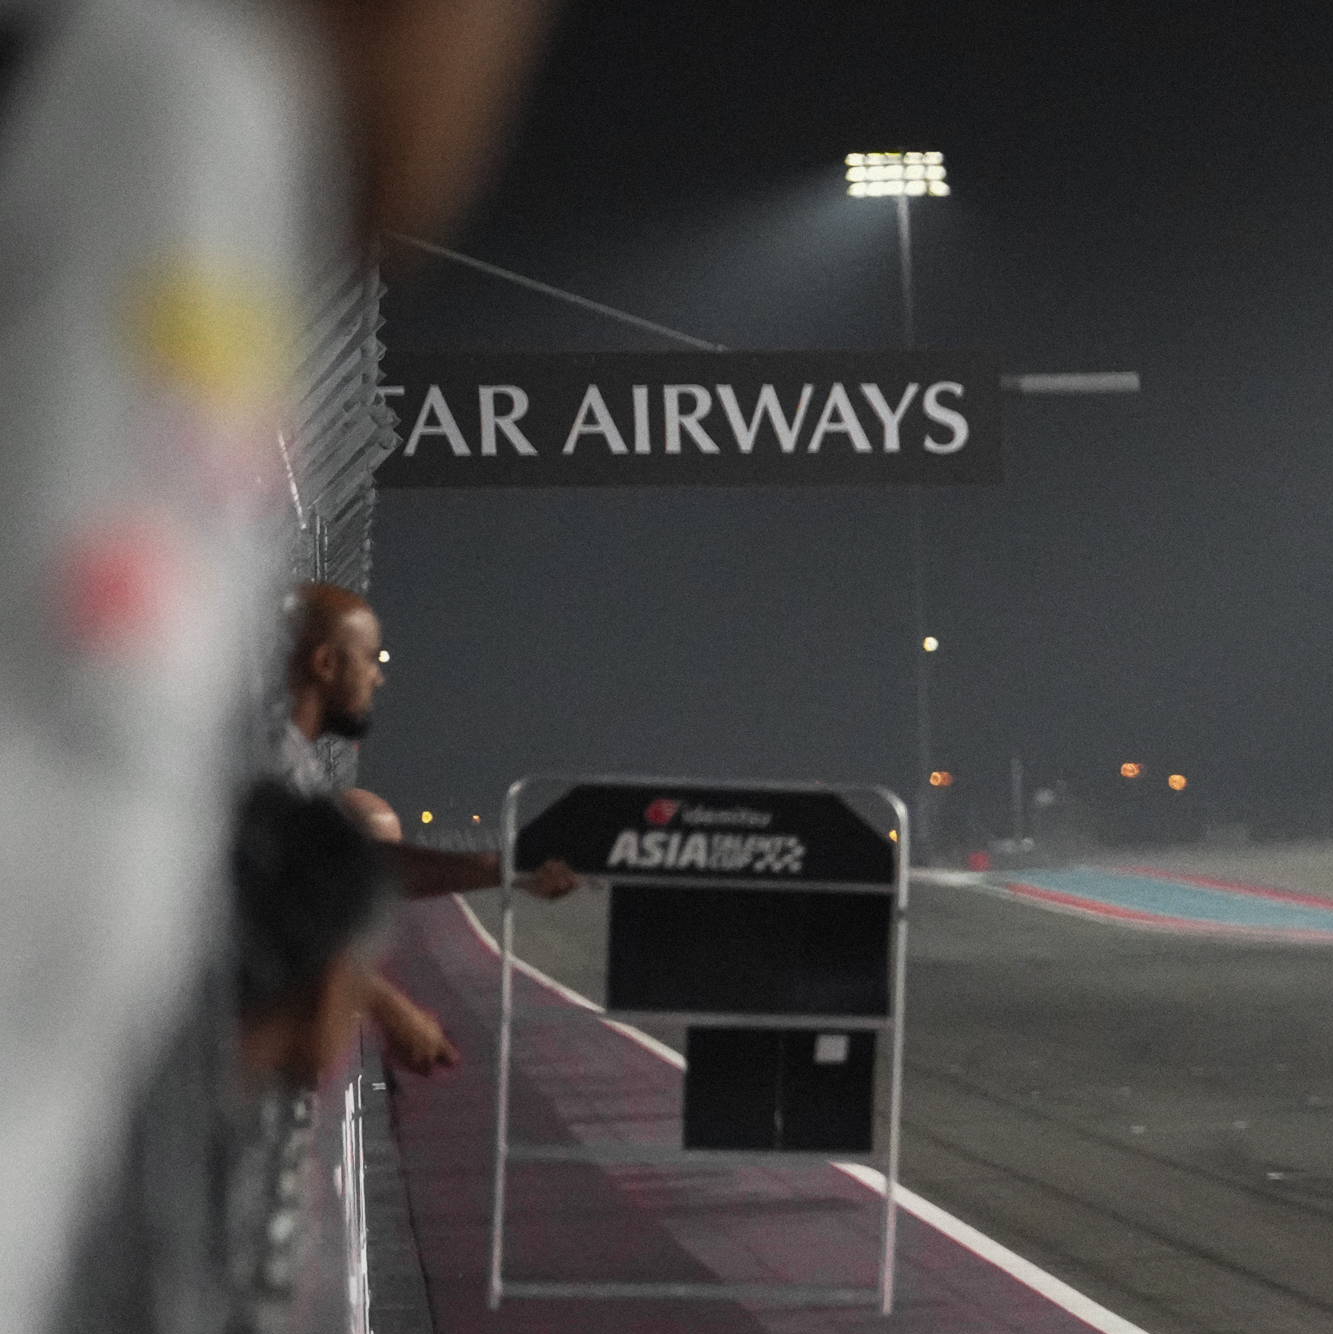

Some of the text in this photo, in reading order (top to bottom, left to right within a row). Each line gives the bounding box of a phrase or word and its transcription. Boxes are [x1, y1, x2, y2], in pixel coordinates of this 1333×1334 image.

[377, 381, 971, 457] AR AIRWAYS
[607, 829, 708, 869] ASIA
